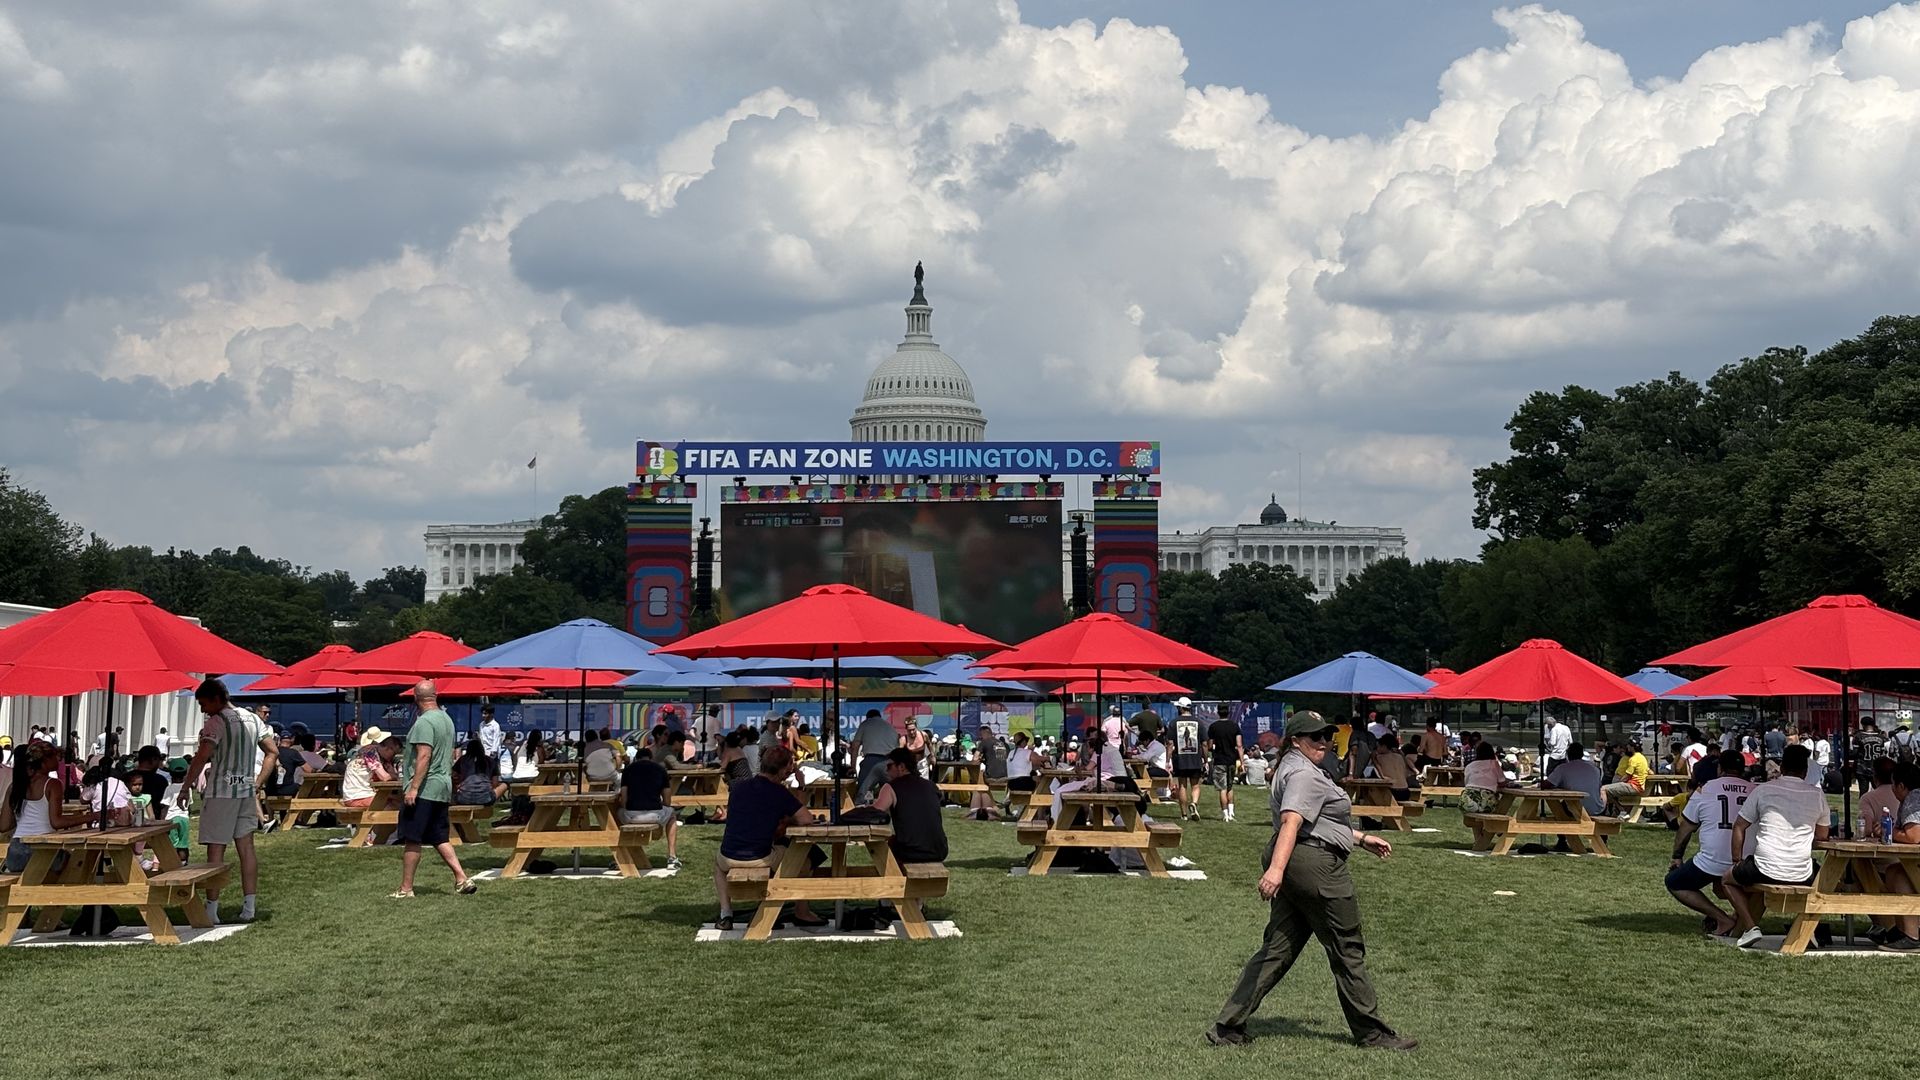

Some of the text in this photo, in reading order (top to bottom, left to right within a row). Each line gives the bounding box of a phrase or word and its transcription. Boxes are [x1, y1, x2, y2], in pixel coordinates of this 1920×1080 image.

[684, 448, 1113, 470] FIFA FAN ZONE WASHINGTON, D.C.
[1031, 515, 1048, 524] FOX
[229, 776, 245, 785] JFK
[1722, 783, 1747, 793] WIRTZ
